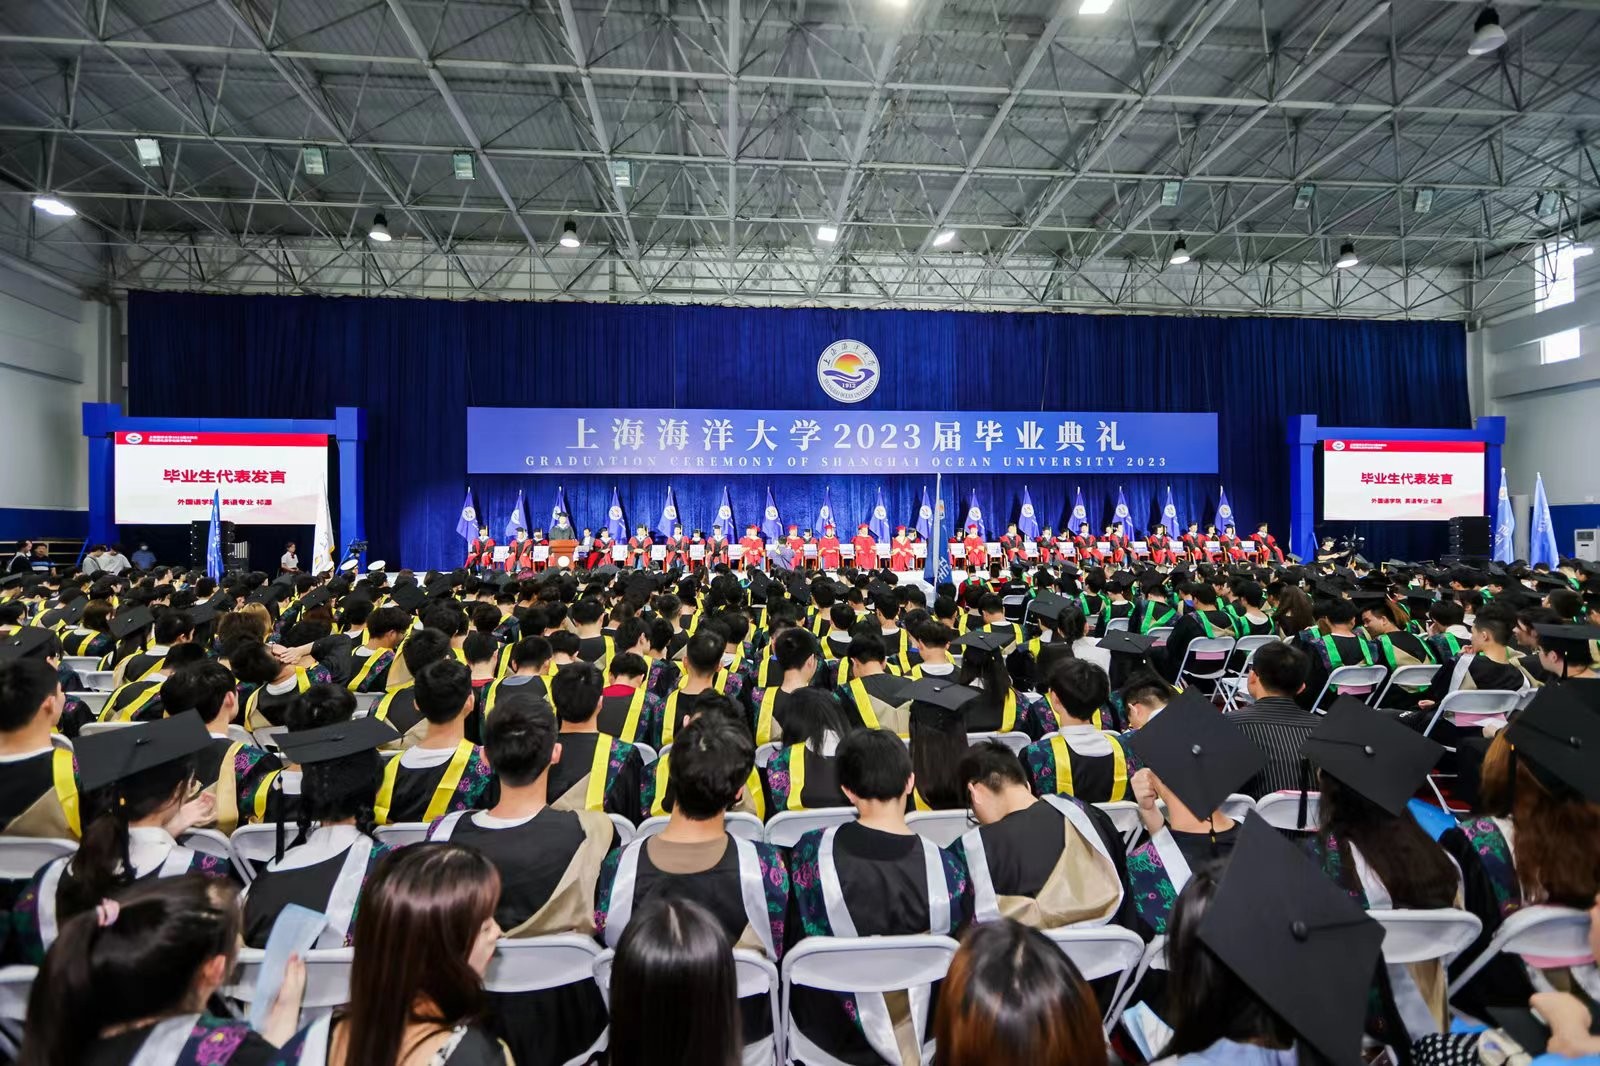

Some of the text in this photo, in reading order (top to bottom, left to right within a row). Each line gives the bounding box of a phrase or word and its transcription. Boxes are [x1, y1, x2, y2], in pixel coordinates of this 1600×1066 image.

[566, 417, 1126, 452] 上海海洋大学2023届毕业典礼
[525, 455, 1167, 467] GRADUATION CEREMONY OF SHANGHAI OCEAN UNIVERSITY 2023
[163, 469, 286, 483] 毕业生代表发言
[1361, 472, 1453, 485] 毕业生代表发言
